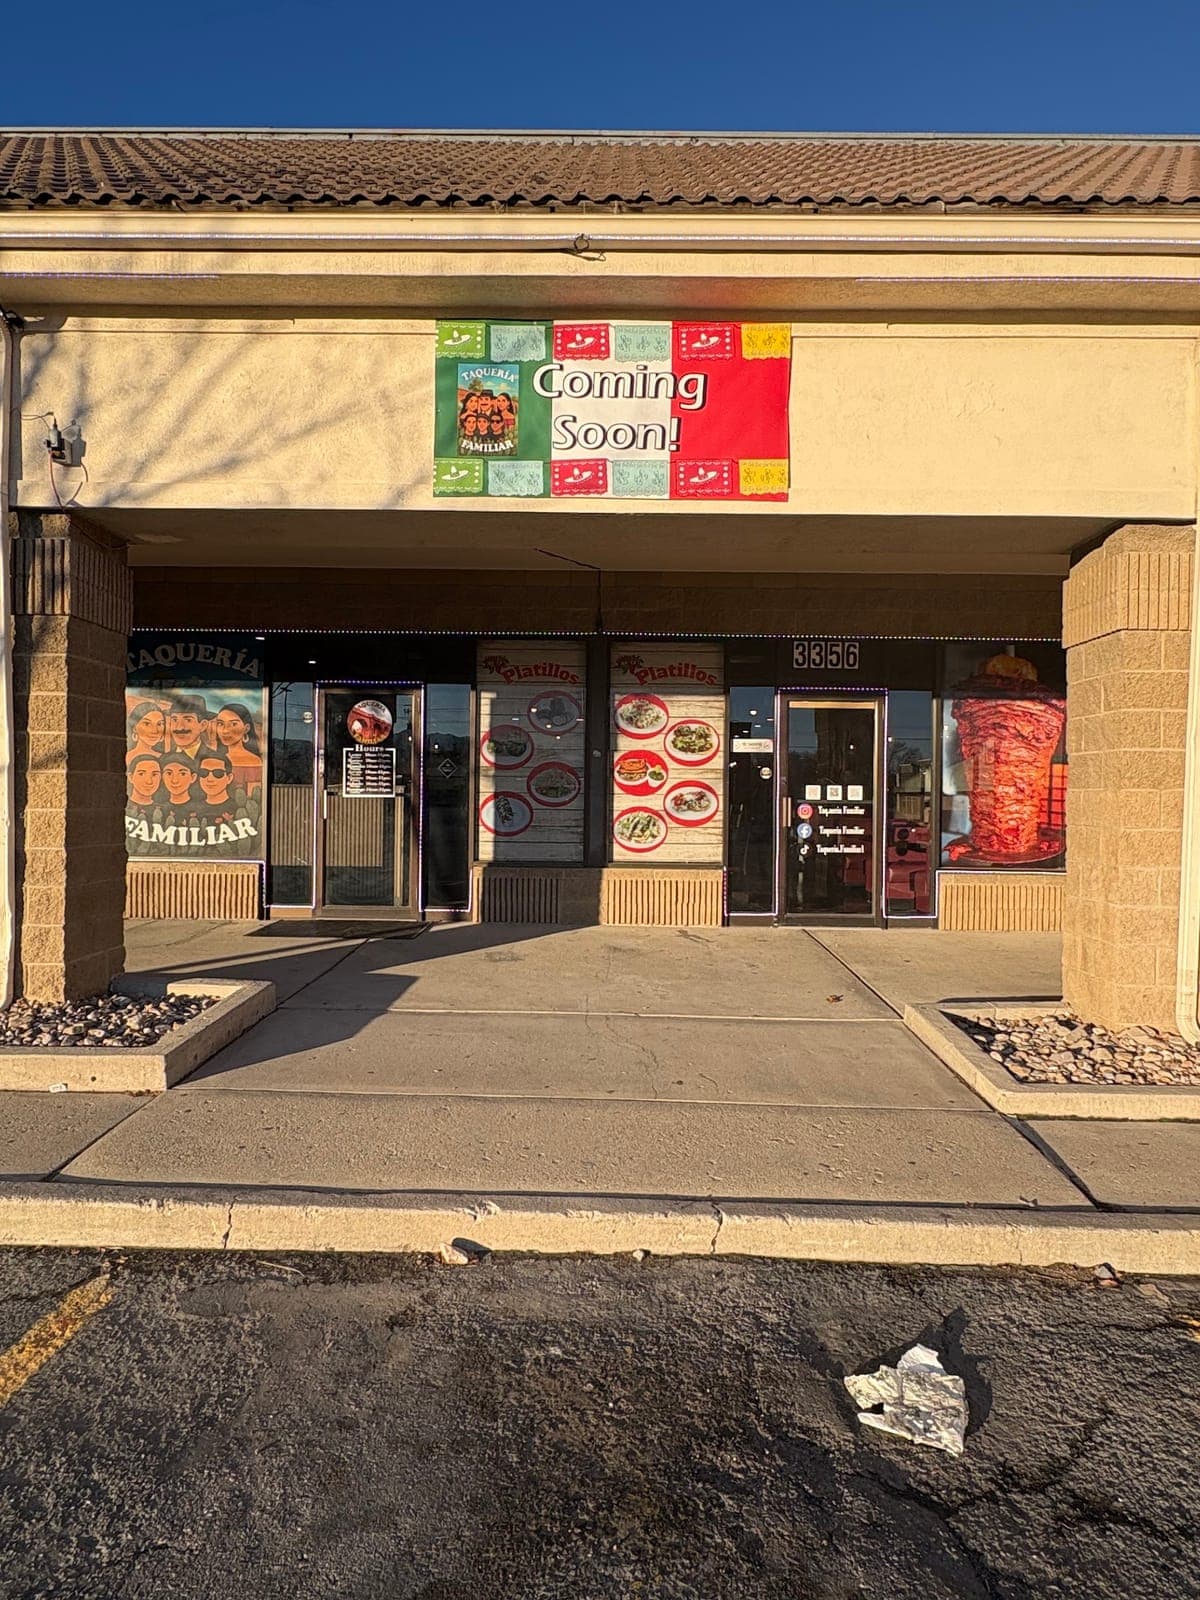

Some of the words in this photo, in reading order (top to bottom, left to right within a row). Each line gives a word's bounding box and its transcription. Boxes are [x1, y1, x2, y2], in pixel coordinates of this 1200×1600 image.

[461, 367, 514, 383] TAQUERÍA
[532, 364, 707, 410] Coming
[553, 415, 680, 451] Soon!
[461, 439, 514, 453] FAMILIAR
[794, 642, 858, 668] 3356
[502, 662, 580, 685] Platillos
[636, 662, 717, 686] Platillos
[355, 744, 385, 752] Hours
